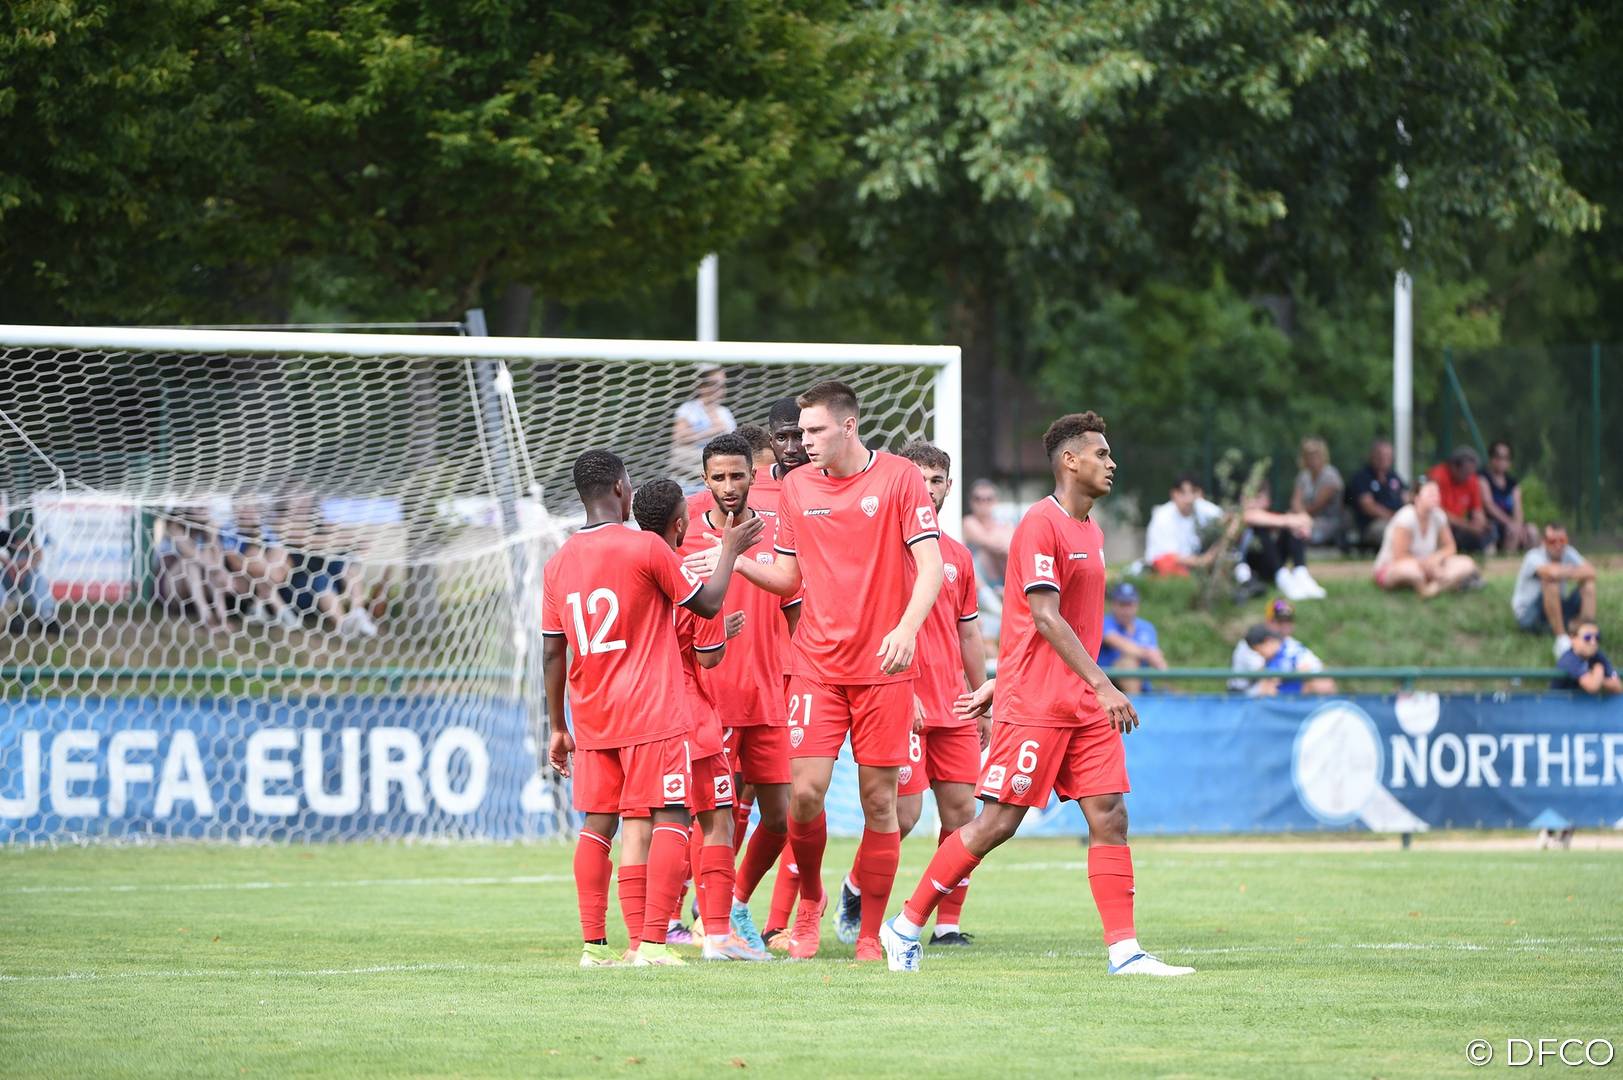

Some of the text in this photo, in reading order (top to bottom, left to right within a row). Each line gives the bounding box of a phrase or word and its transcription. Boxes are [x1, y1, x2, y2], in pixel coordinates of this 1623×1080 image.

[566, 587, 627, 657] 12
[787, 693, 813, 726] 21
[246, 726, 489, 816] EURO
[1017, 740, 1040, 774] 6
[1390, 733, 1623, 788] NORTHER
